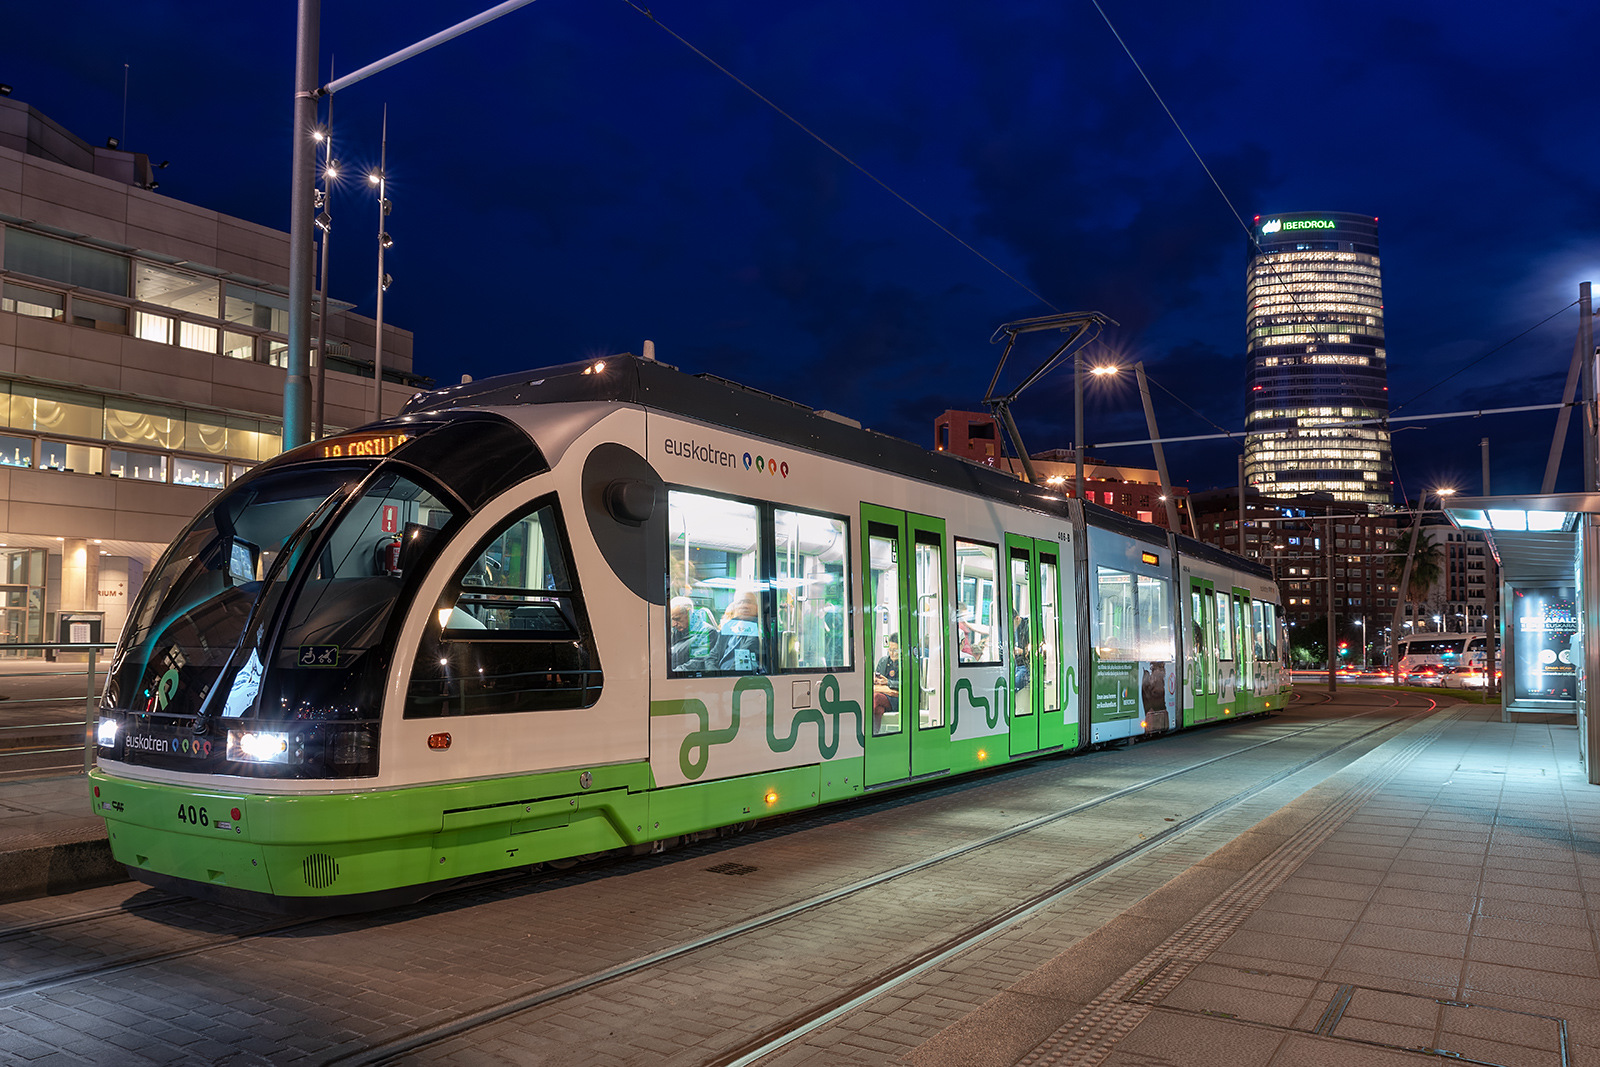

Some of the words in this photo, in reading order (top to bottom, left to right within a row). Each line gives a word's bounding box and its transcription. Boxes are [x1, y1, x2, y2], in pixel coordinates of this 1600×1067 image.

[1282, 220, 1335, 231] IBERDROLA
[664, 438, 737, 469] euskotren
[125, 733, 169, 753] euskotren
[177, 803, 209, 827] 406
